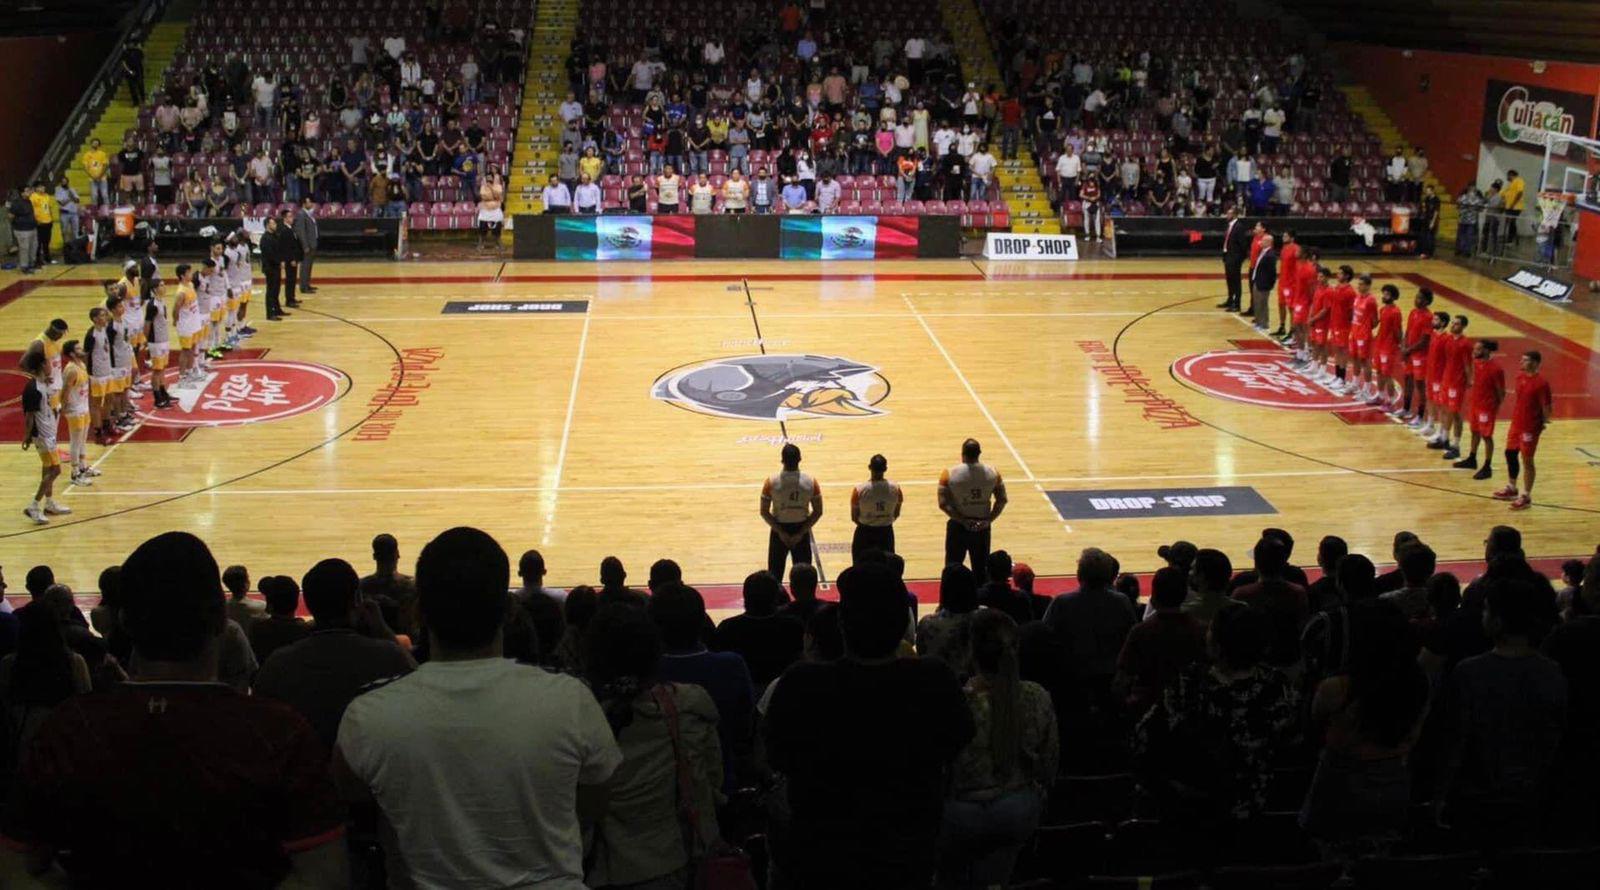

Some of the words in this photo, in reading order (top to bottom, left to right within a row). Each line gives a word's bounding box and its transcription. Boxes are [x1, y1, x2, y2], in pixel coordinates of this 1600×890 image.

[1498, 87, 1574, 142] Culiacán
[202, 374, 252, 412] Pizza
[248, 375, 291, 406] Hut
